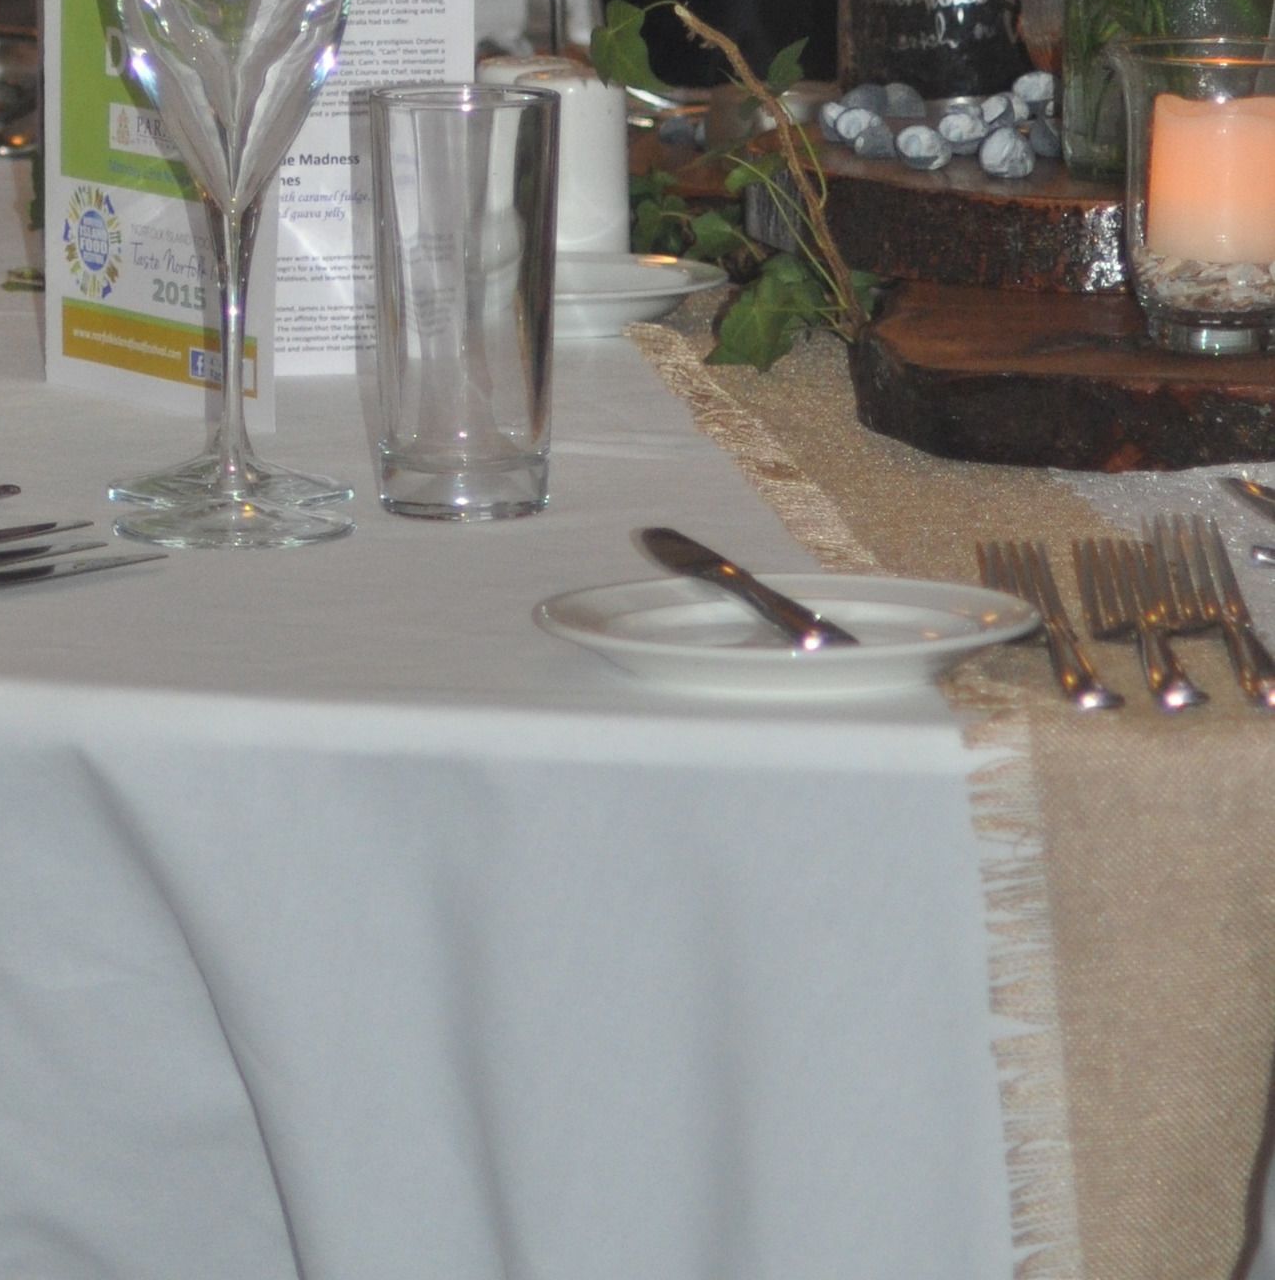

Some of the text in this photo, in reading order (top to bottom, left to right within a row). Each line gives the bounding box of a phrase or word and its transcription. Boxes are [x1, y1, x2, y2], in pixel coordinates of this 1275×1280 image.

[367, 7, 381, 16] end
[381, 7, 390, 16] of
[390, 7, 419, 17] Cooking
[420, 7, 434, 16] and
[435, 6, 446, 15] led
[368, 18, 382, 26] had
[383, 18, 391, 26] to
[376, 38, 414, 47] prestigious
[402, 47, 419, 55] then
[420, 47, 439, 56] spent
[358, 57, 380, 67] Cam's
[381, 58, 400, 66] most
[401, 57, 446, 66] international
[409, 67, 432, 77] taking
[299, 151, 360, 167] Madness
[298, 190, 337, 203] caramel
[289, 208, 322, 222] guava
[322, 206, 346, 221] jelly
[130, 241, 160, 270] Taste
[295, 254, 310, 262] with
[297, 264, 308, 272] for
[310, 274, 323, 282] and
[151, 278, 207, 310] 2015
[294, 313, 317, 323] affinity
[318, 313, 329, 321] for
[277, 325, 289, 333] The
[314, 324, 329, 332] that
[331, 323, 342, 332] the
[331, 333, 339, 342] of
[288, 344, 301, 353] and
